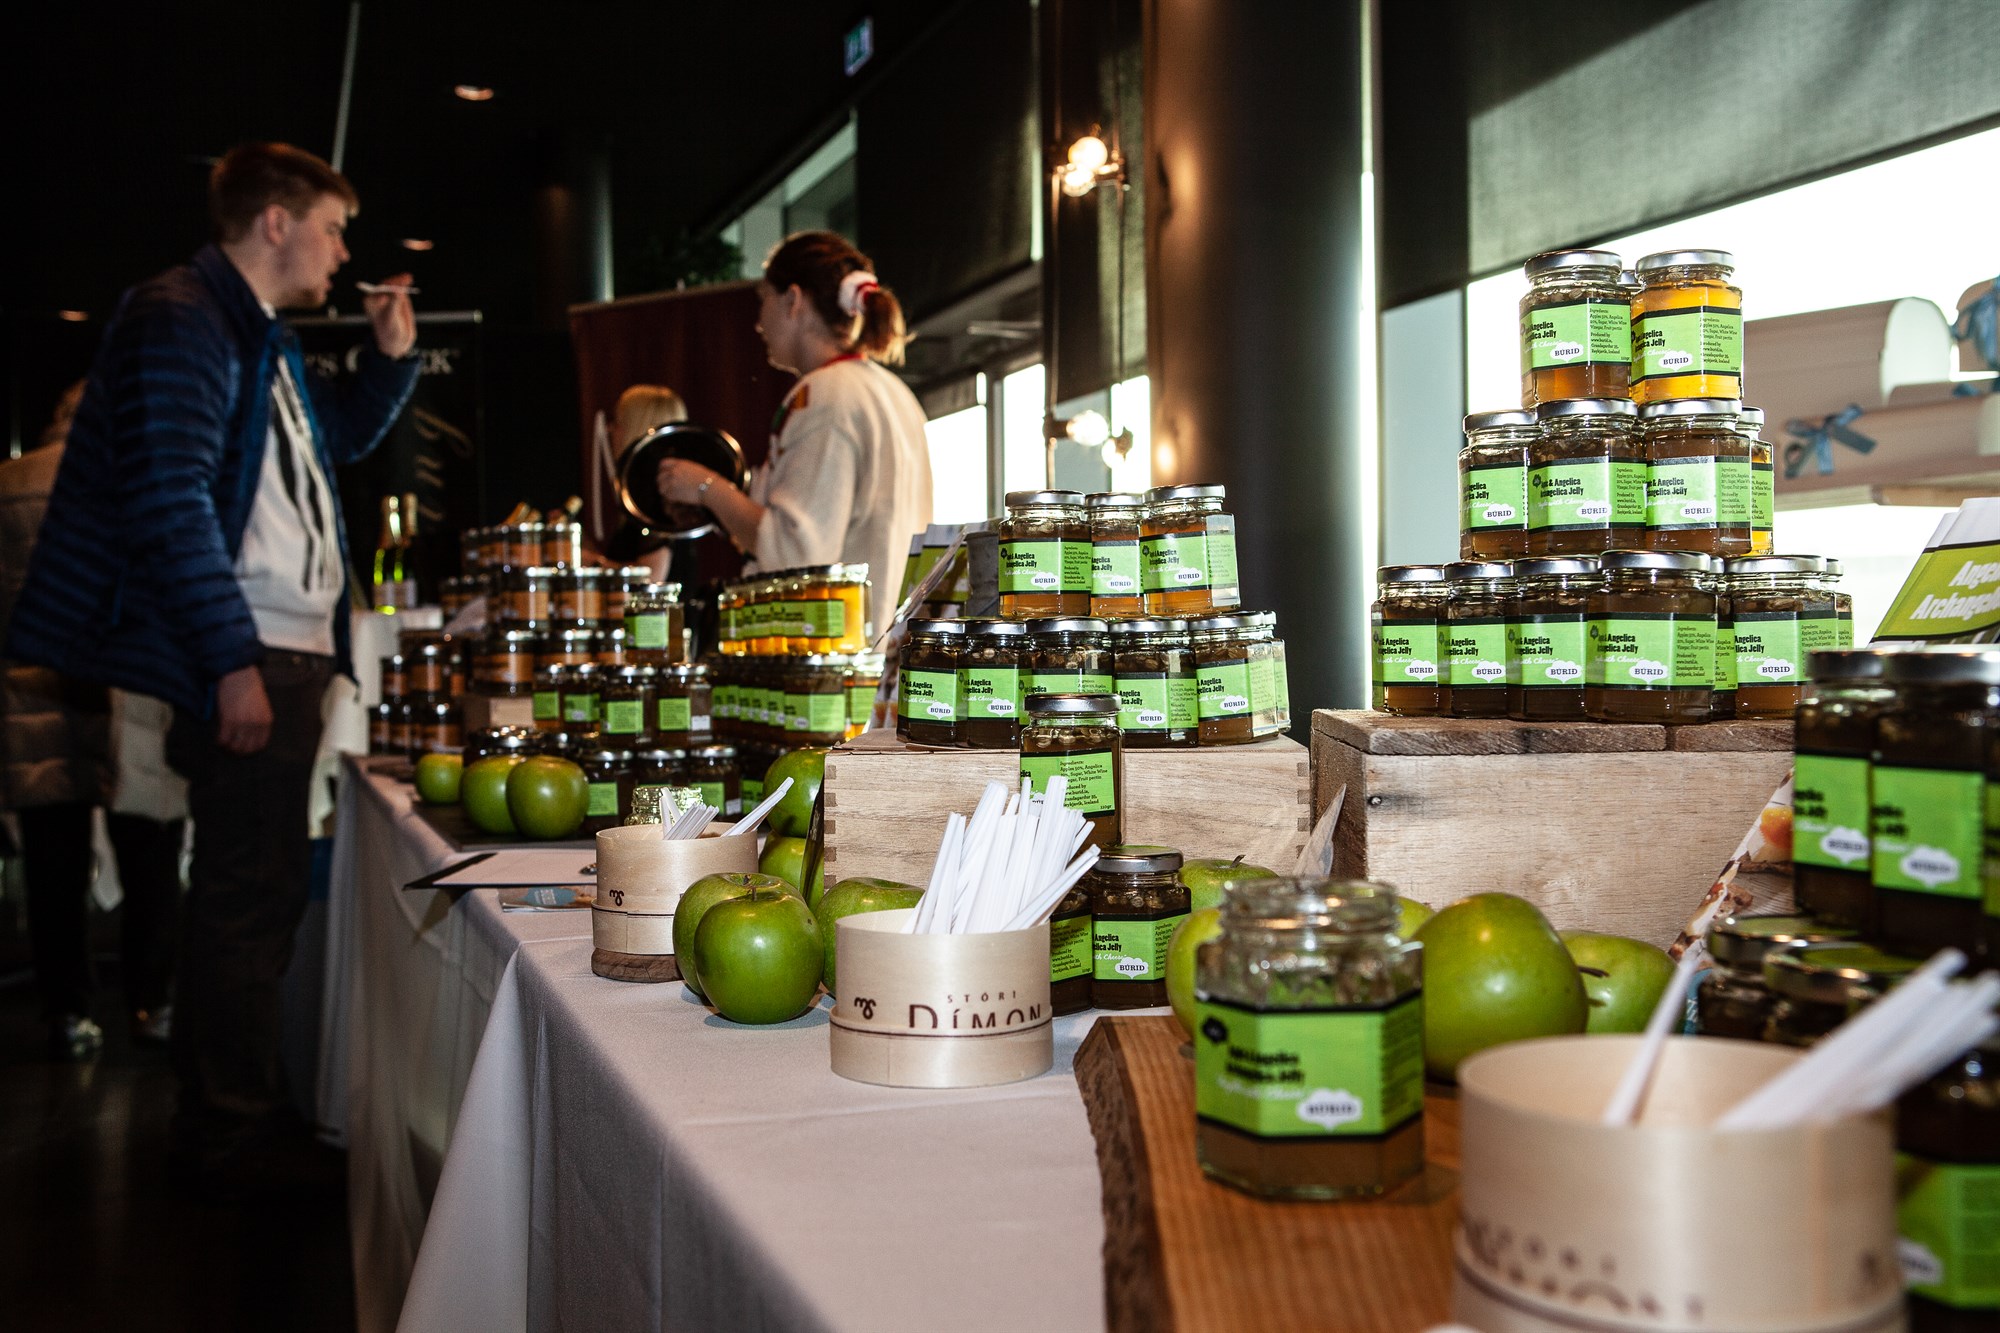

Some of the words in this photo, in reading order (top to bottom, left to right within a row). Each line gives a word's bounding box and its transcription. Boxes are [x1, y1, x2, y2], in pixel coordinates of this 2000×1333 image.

[1542, 329, 1557, 339] Jelly
[1651, 338, 1665, 347] Jelly
[1554, 478, 1580, 488] Angelica
[1658, 478, 1684, 487] Angelica
[1476, 491, 1489, 500] Jelly
[1569, 486, 1584, 496] Jelly
[1672, 486, 1687, 496] Jelly
[1157, 549, 1177, 558] Angelica
[1025, 560, 1037, 568] Jelly
[1168, 556, 1180, 564] Jelly
[1101, 564, 1112, 572] Jelly
[1386, 638, 1410, 646] Angelica
[1451, 638, 1476, 647] Angelica
[1524, 636, 1550, 646] Angelica
[1608, 634, 1636, 643] Angelica
[1735, 635, 1762, 644] Angelica
[1398, 647, 1412, 656] Jelly
[1464, 647, 1478, 656] Jelly
[1538, 646, 1553, 656] Jelly
[1622, 644, 1638, 654] Jelly
[1748, 644, 1764, 654] Jelly
[913, 682, 932, 690] Angelica
[970, 679, 991, 687] Angelica
[1200, 678, 1221, 687] Angelica
[922, 689, 934, 697] Jelly
[1120, 690, 1140, 698] Angelica
[1095, 934, 1120, 942] Angelica
[1108, 944, 1122, 952] Jelly
